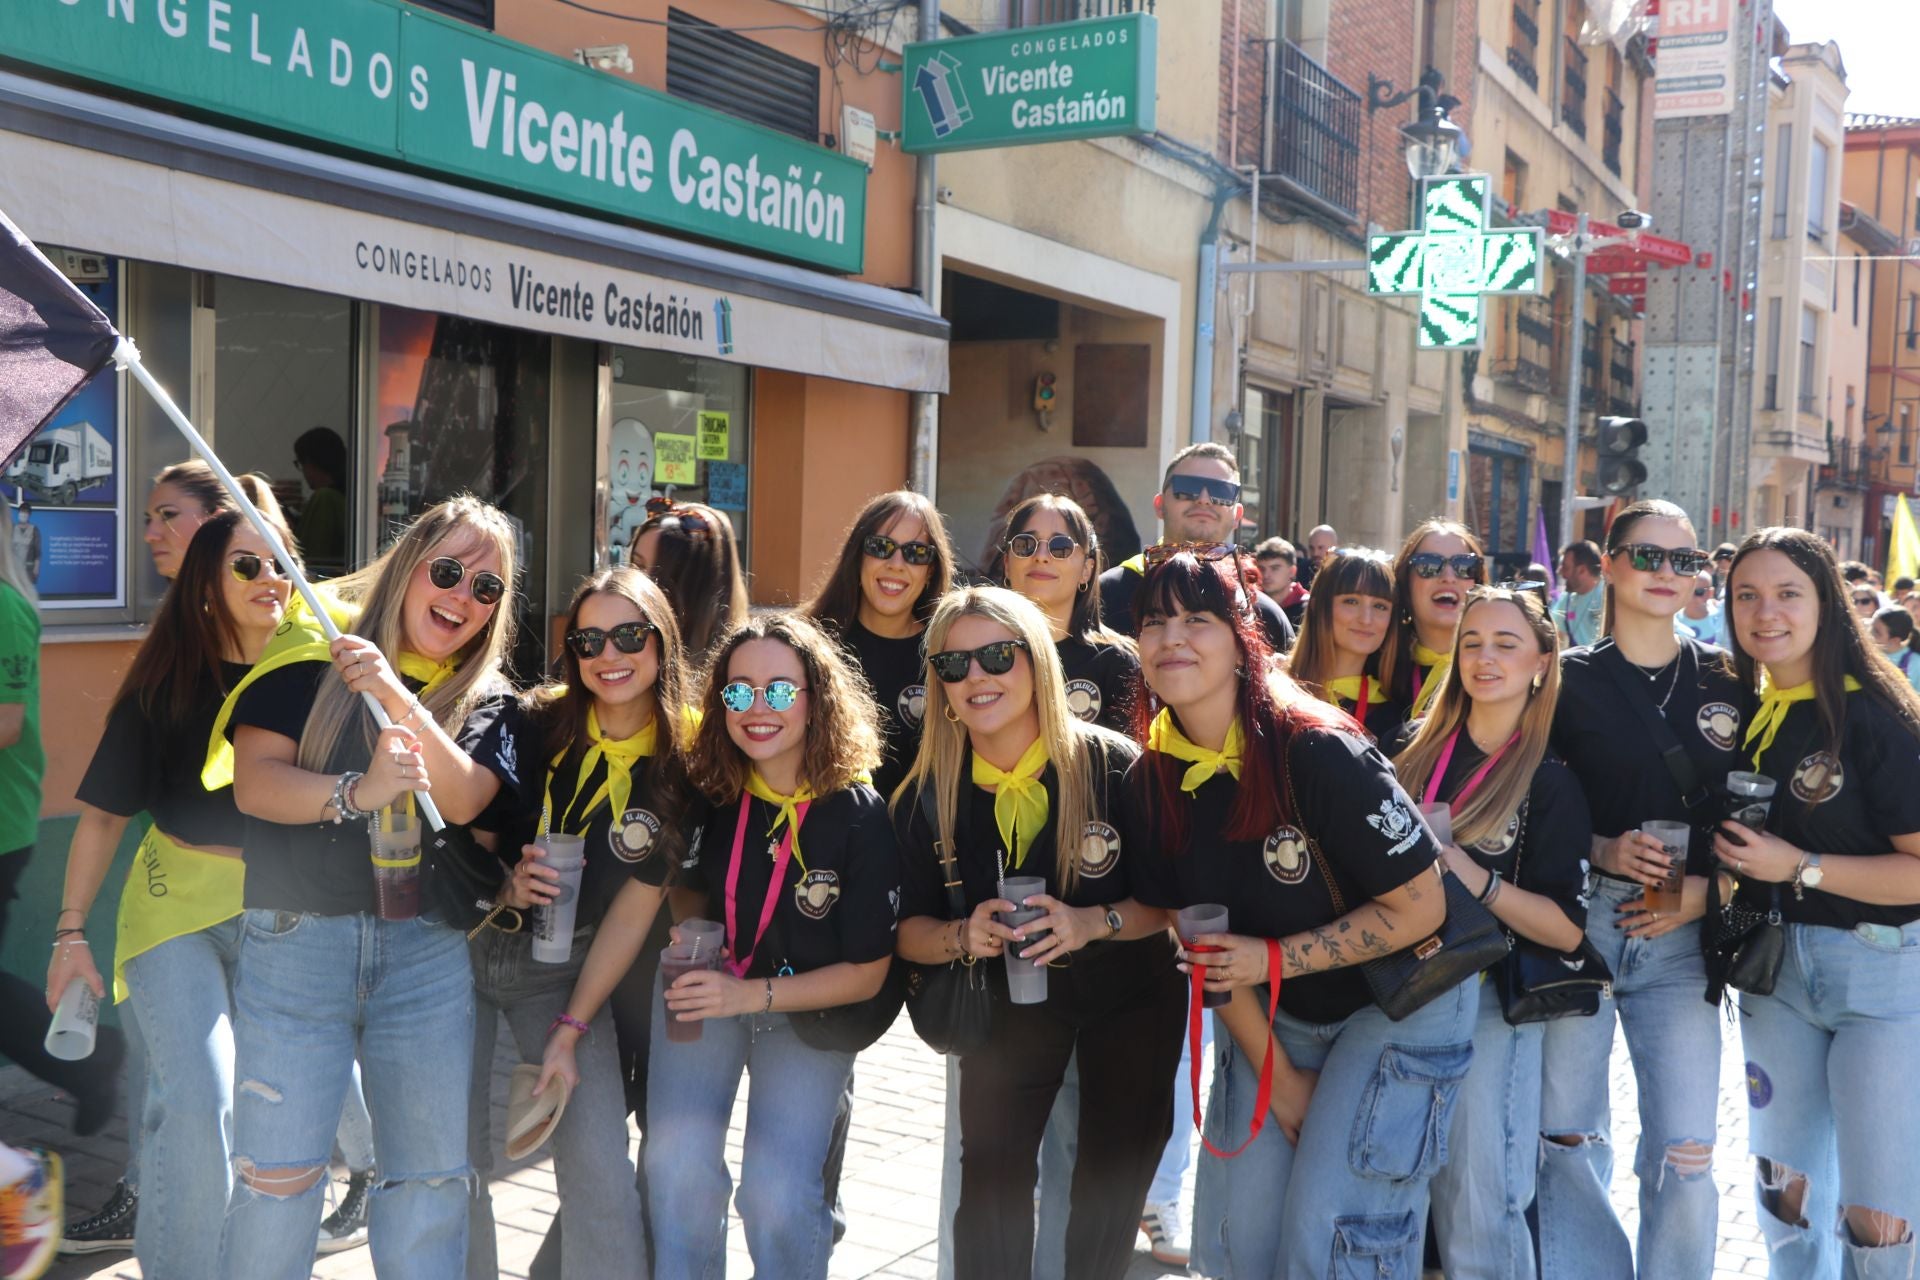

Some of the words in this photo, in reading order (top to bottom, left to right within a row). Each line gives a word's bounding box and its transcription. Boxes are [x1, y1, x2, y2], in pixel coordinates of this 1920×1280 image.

[1666, 0, 1718, 27] RH
[1011, 29, 1128, 57] CONGELADOS
[981, 60, 1073, 96] Vicente
[1011, 89, 1126, 129] Castañón
[461, 58, 654, 193] Vicente
[668, 128, 845, 245] Castañón
[355, 241, 492, 293] CONGELADOS
[509, 262, 594, 322] Vicente
[604, 282, 704, 341] Castañón
